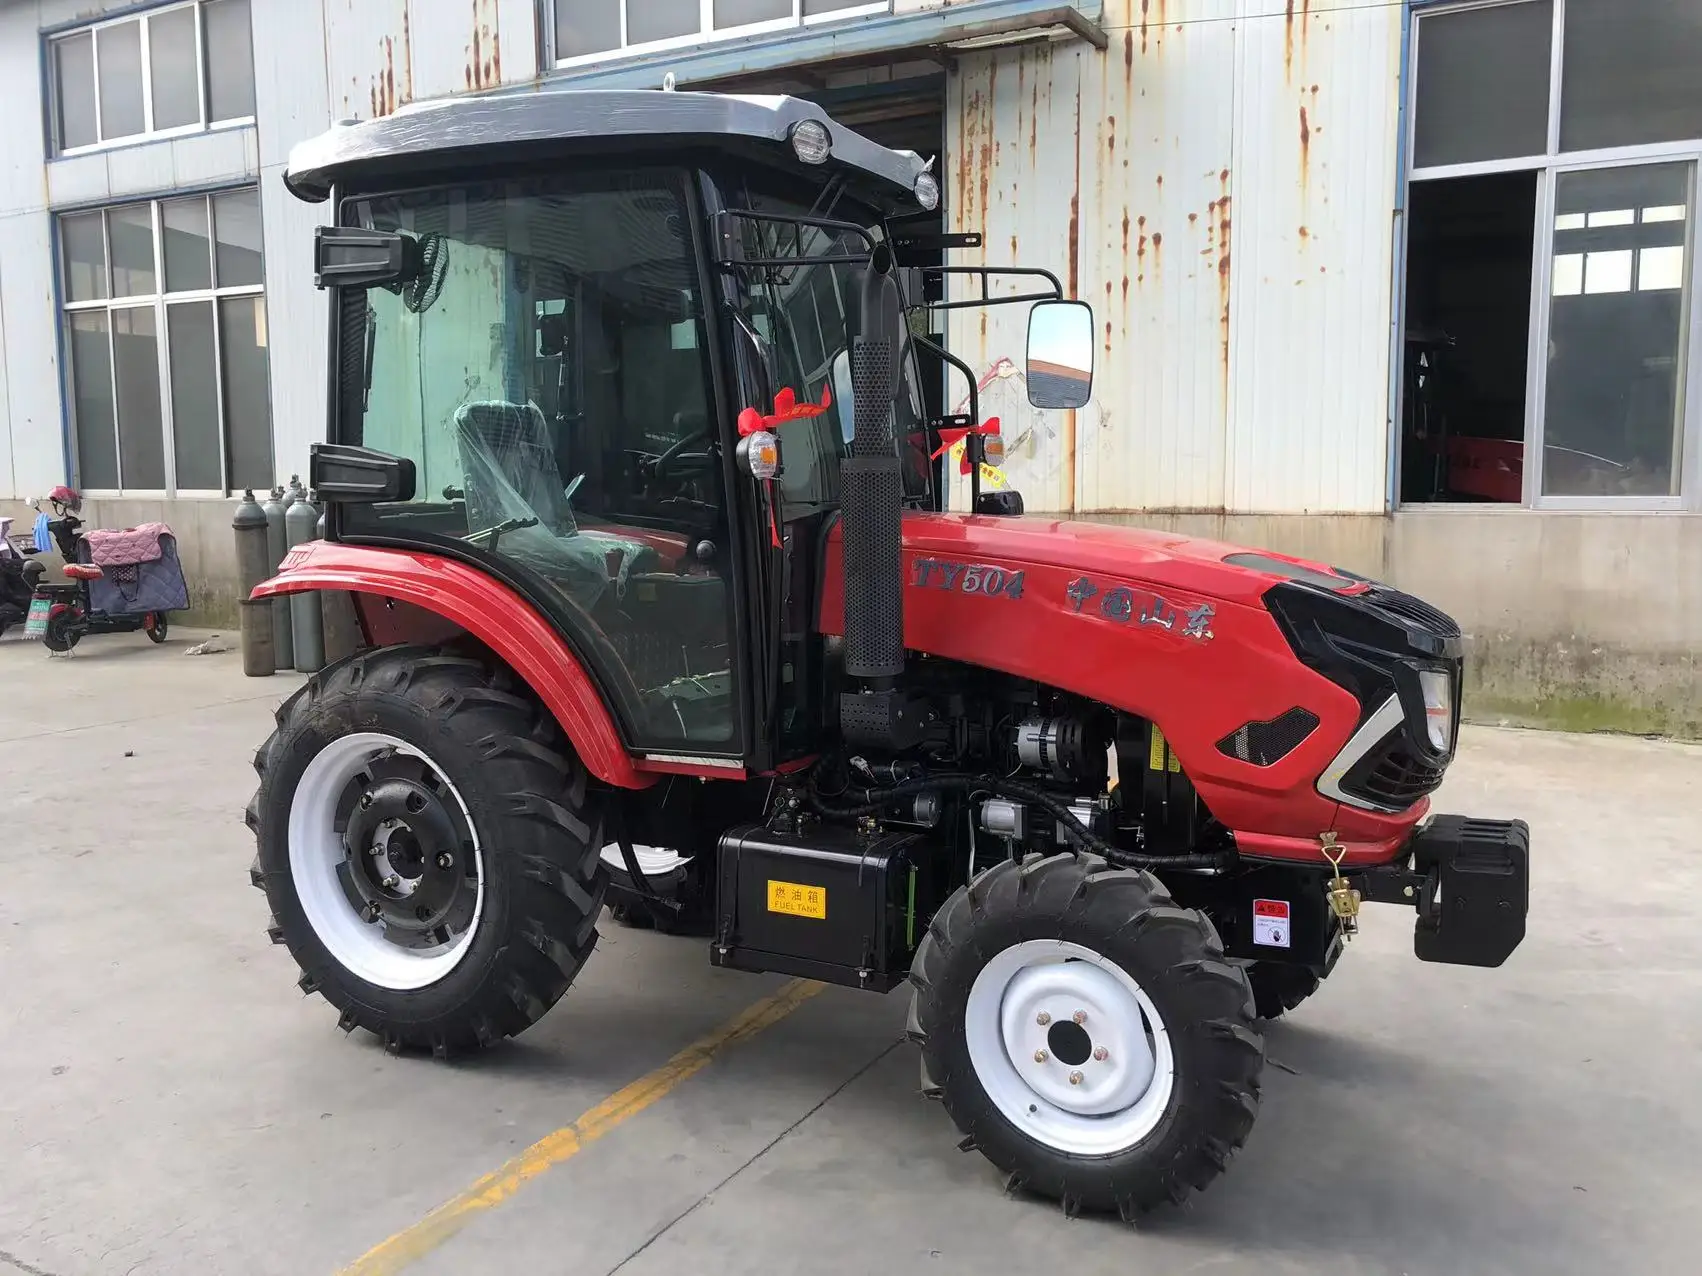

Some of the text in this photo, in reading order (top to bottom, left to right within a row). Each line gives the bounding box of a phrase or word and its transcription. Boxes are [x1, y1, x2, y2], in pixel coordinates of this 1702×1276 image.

[911, 558, 1025, 600] TY504
[775, 885, 818, 903] 燃油箱
[774, 900, 818, 913] FUEL TANK
